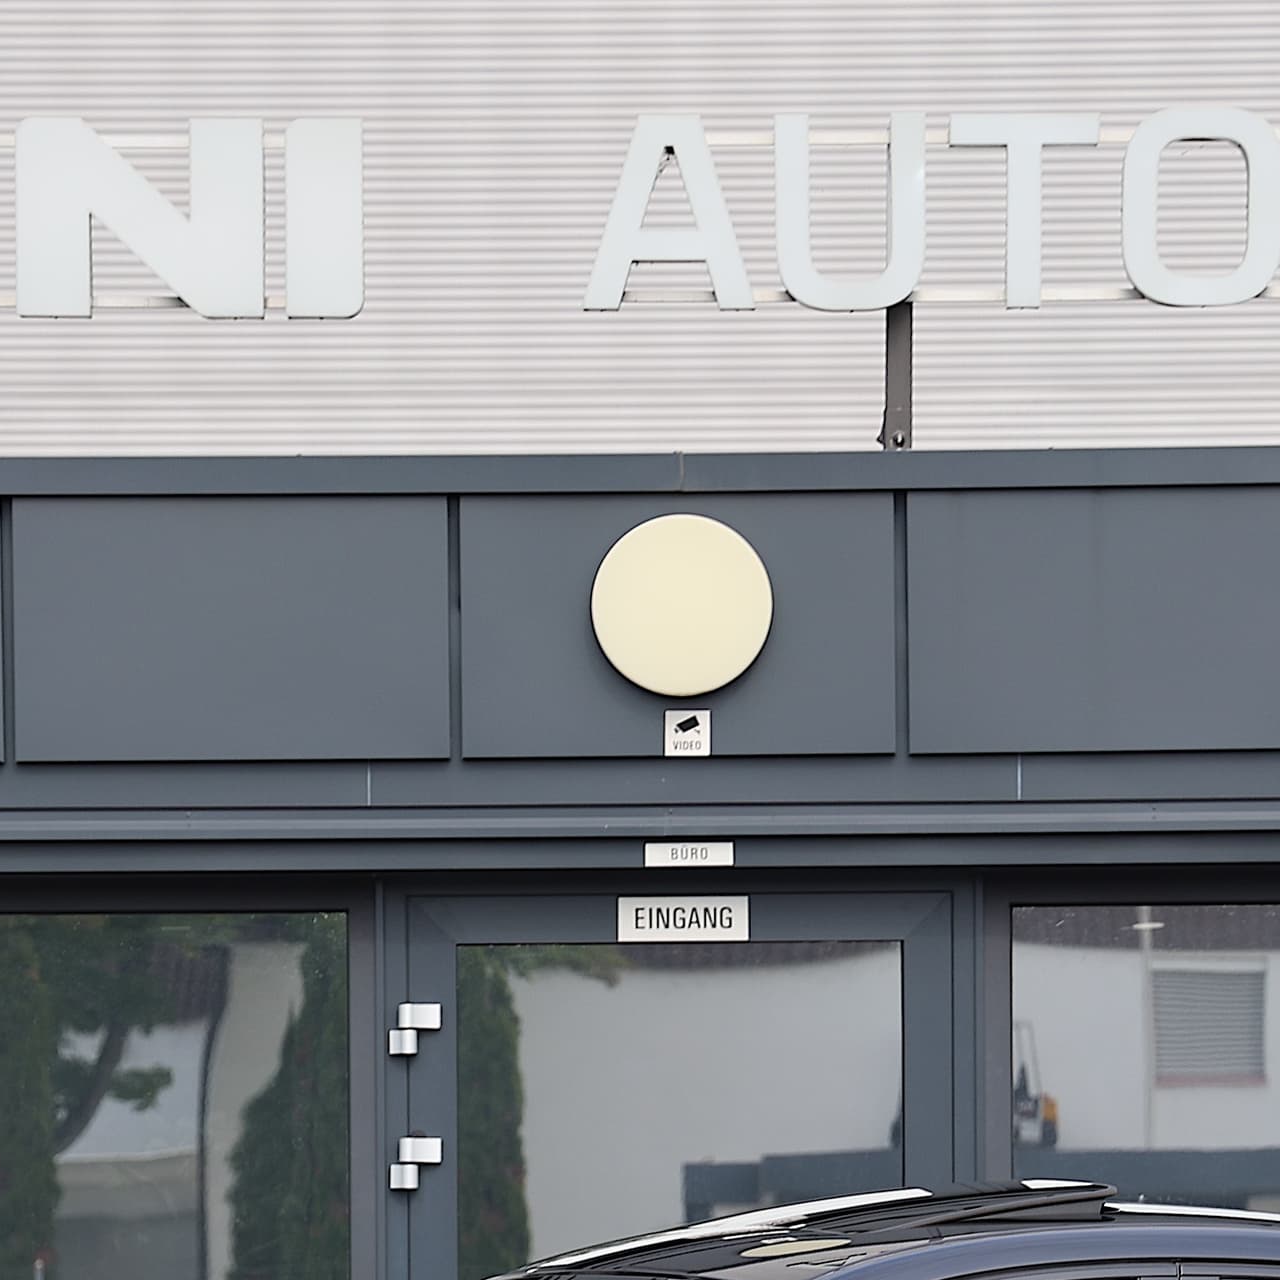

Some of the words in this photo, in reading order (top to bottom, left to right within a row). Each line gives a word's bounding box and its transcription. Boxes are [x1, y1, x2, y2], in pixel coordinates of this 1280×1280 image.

[672, 740, 702, 751] VIDEO
[670, 845, 709, 861] BÜRO
[634, 906, 733, 930] EINGANG
